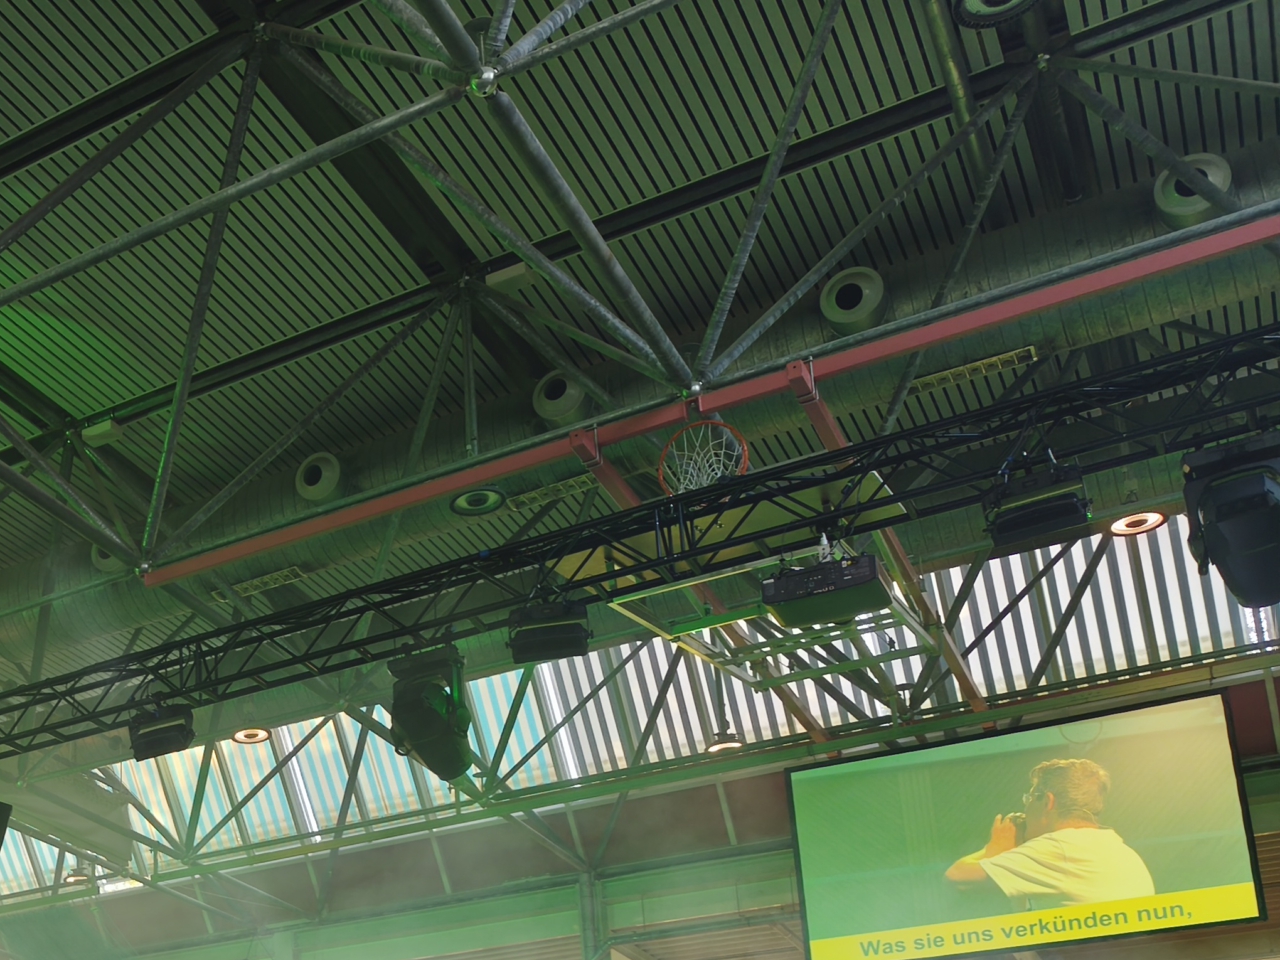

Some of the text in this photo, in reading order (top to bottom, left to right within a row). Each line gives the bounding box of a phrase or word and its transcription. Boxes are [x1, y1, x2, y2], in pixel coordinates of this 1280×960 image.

[859, 904, 1193, 957] Was sie uns verkünden nun,
